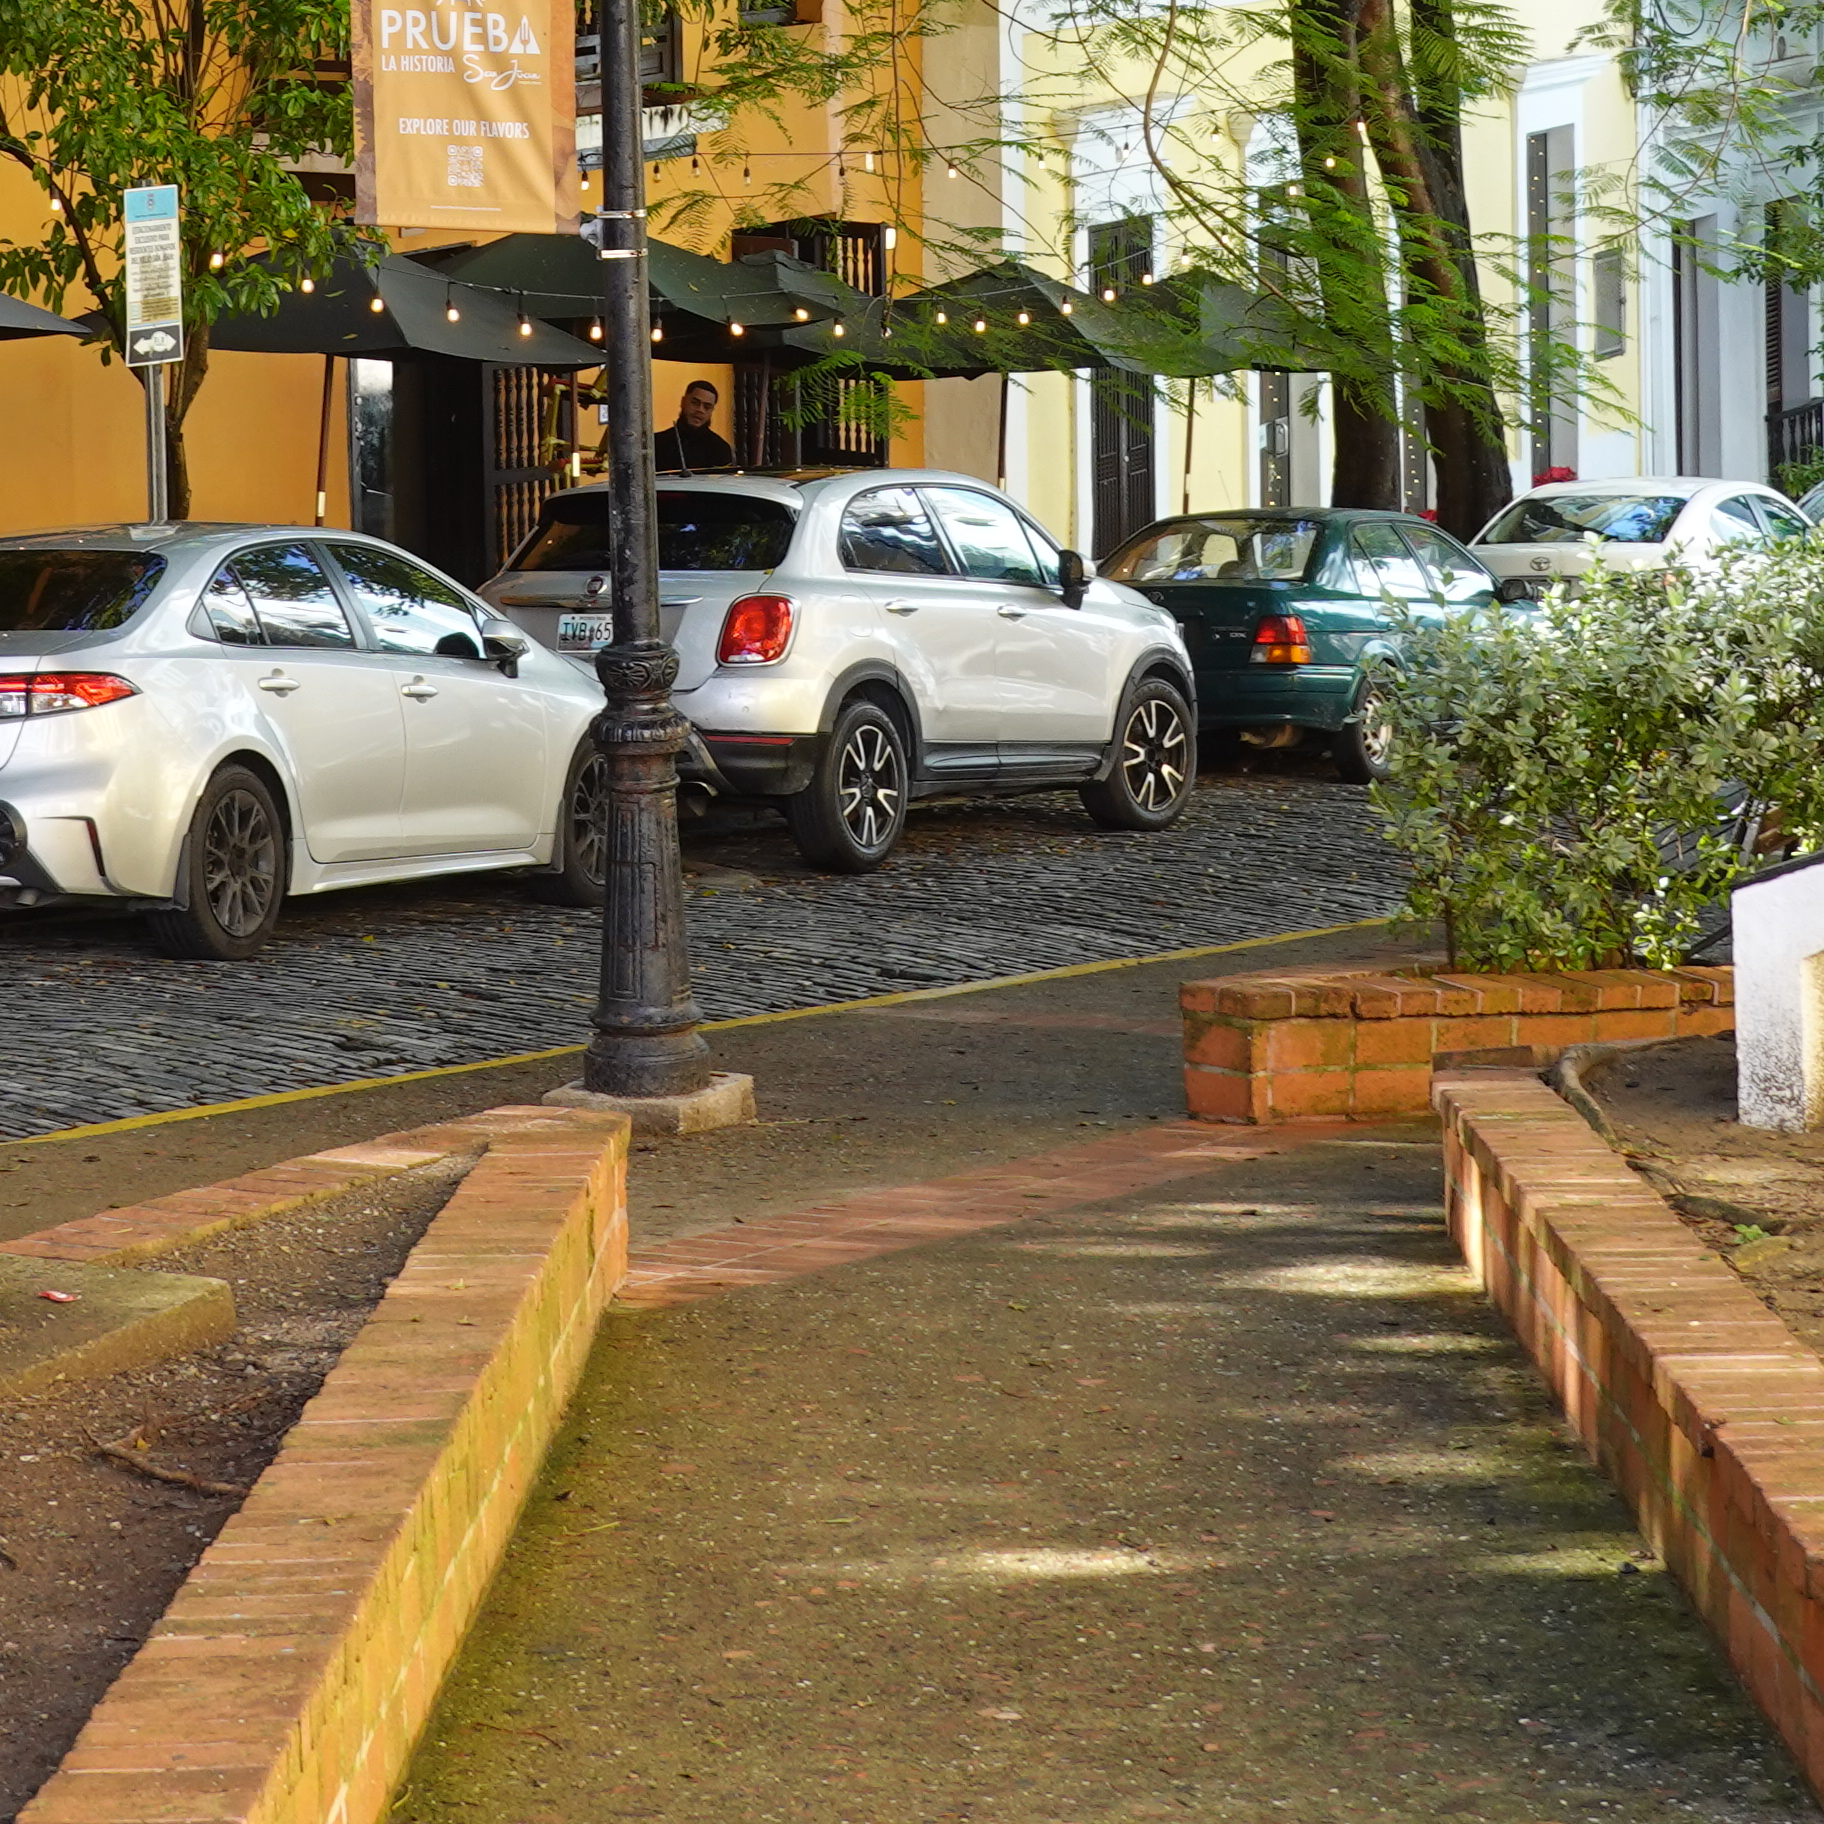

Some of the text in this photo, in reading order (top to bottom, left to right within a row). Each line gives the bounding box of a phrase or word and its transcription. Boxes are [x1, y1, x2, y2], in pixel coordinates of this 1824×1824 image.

[381, 9, 541, 55] PRUEBA
[381, 54, 397, 72] LA
[400, 55, 456, 73] HISTORIA
[398, 118, 530, 140] EXPLORE OUR FLAVORS
[595, 622, 613, 641] 65
